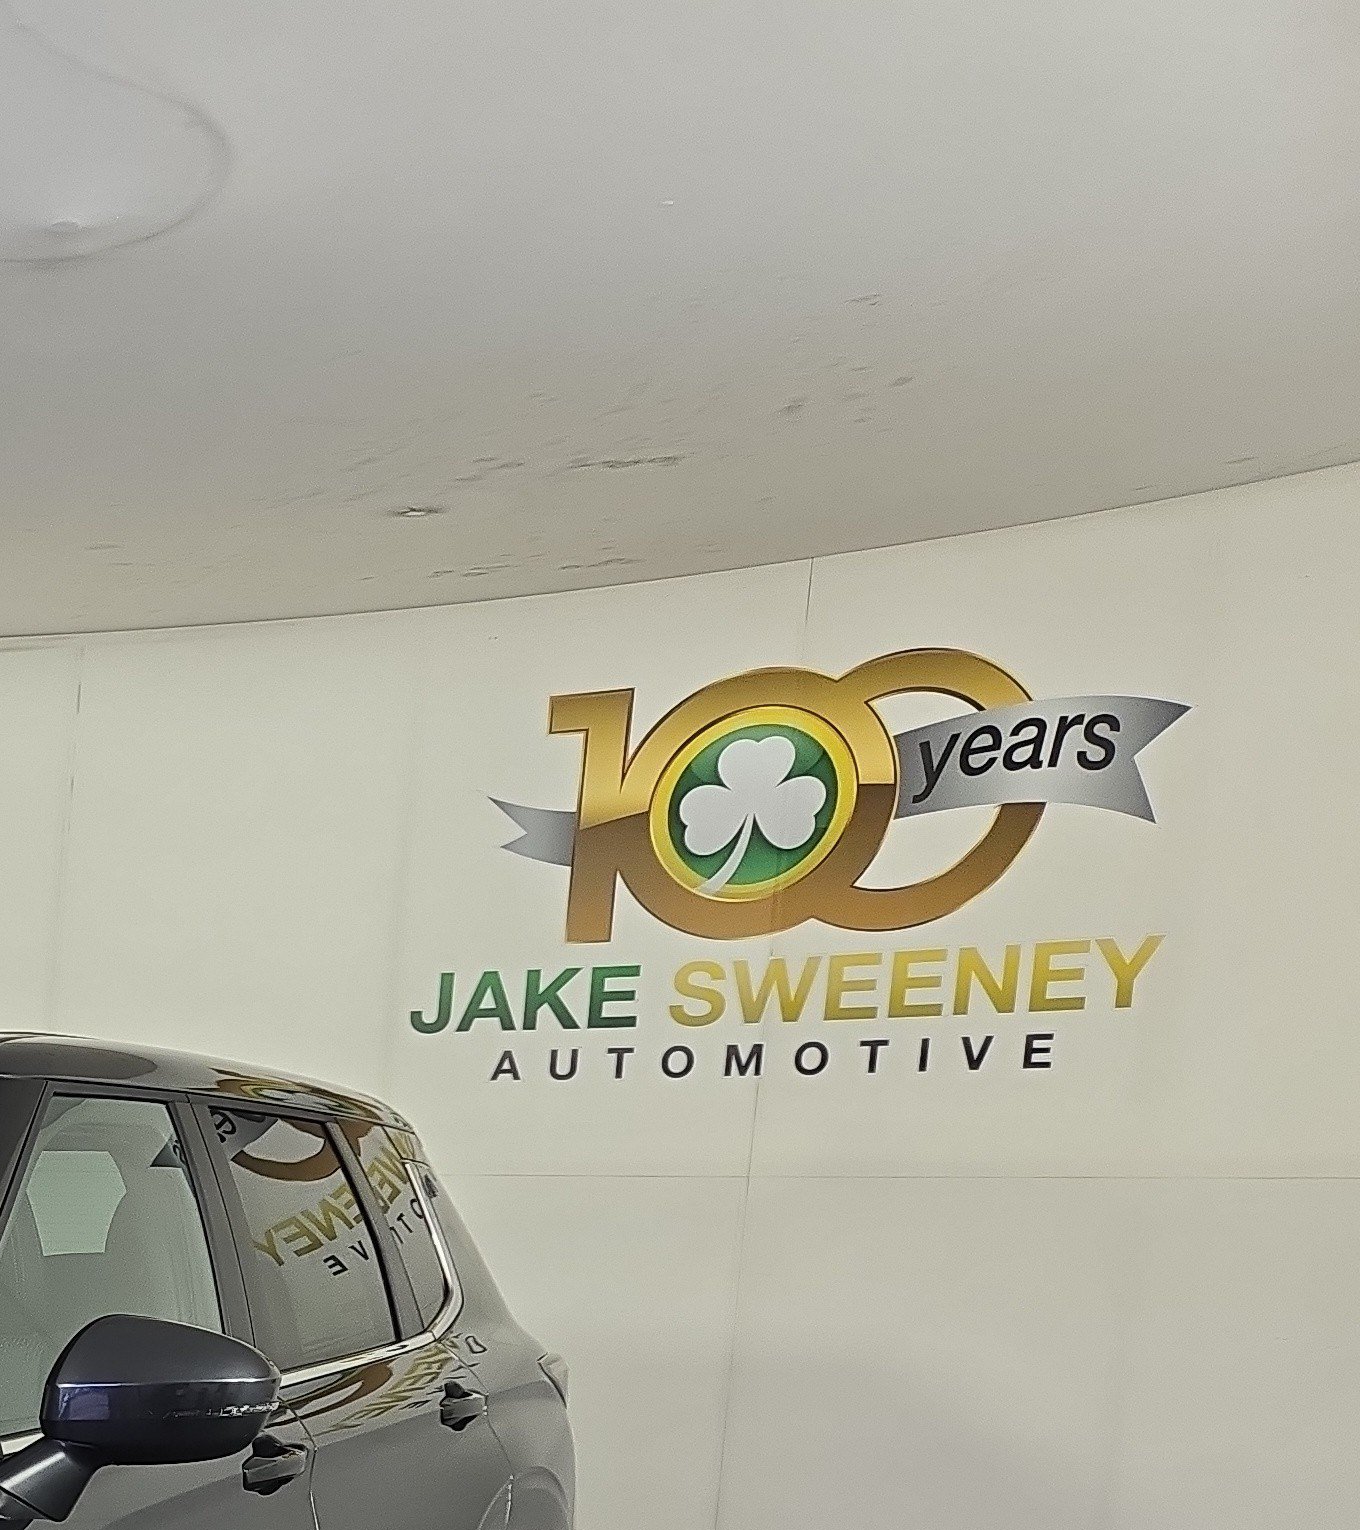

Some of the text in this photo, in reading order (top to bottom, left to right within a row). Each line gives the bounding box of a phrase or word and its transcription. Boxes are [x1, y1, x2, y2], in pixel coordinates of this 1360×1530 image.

[548, 647, 1120, 943] 100 years
[410, 934, 1165, 1035] JAKE SWEENEY
[490, 1032, 1055, 1082] AUTOMOTIVE
